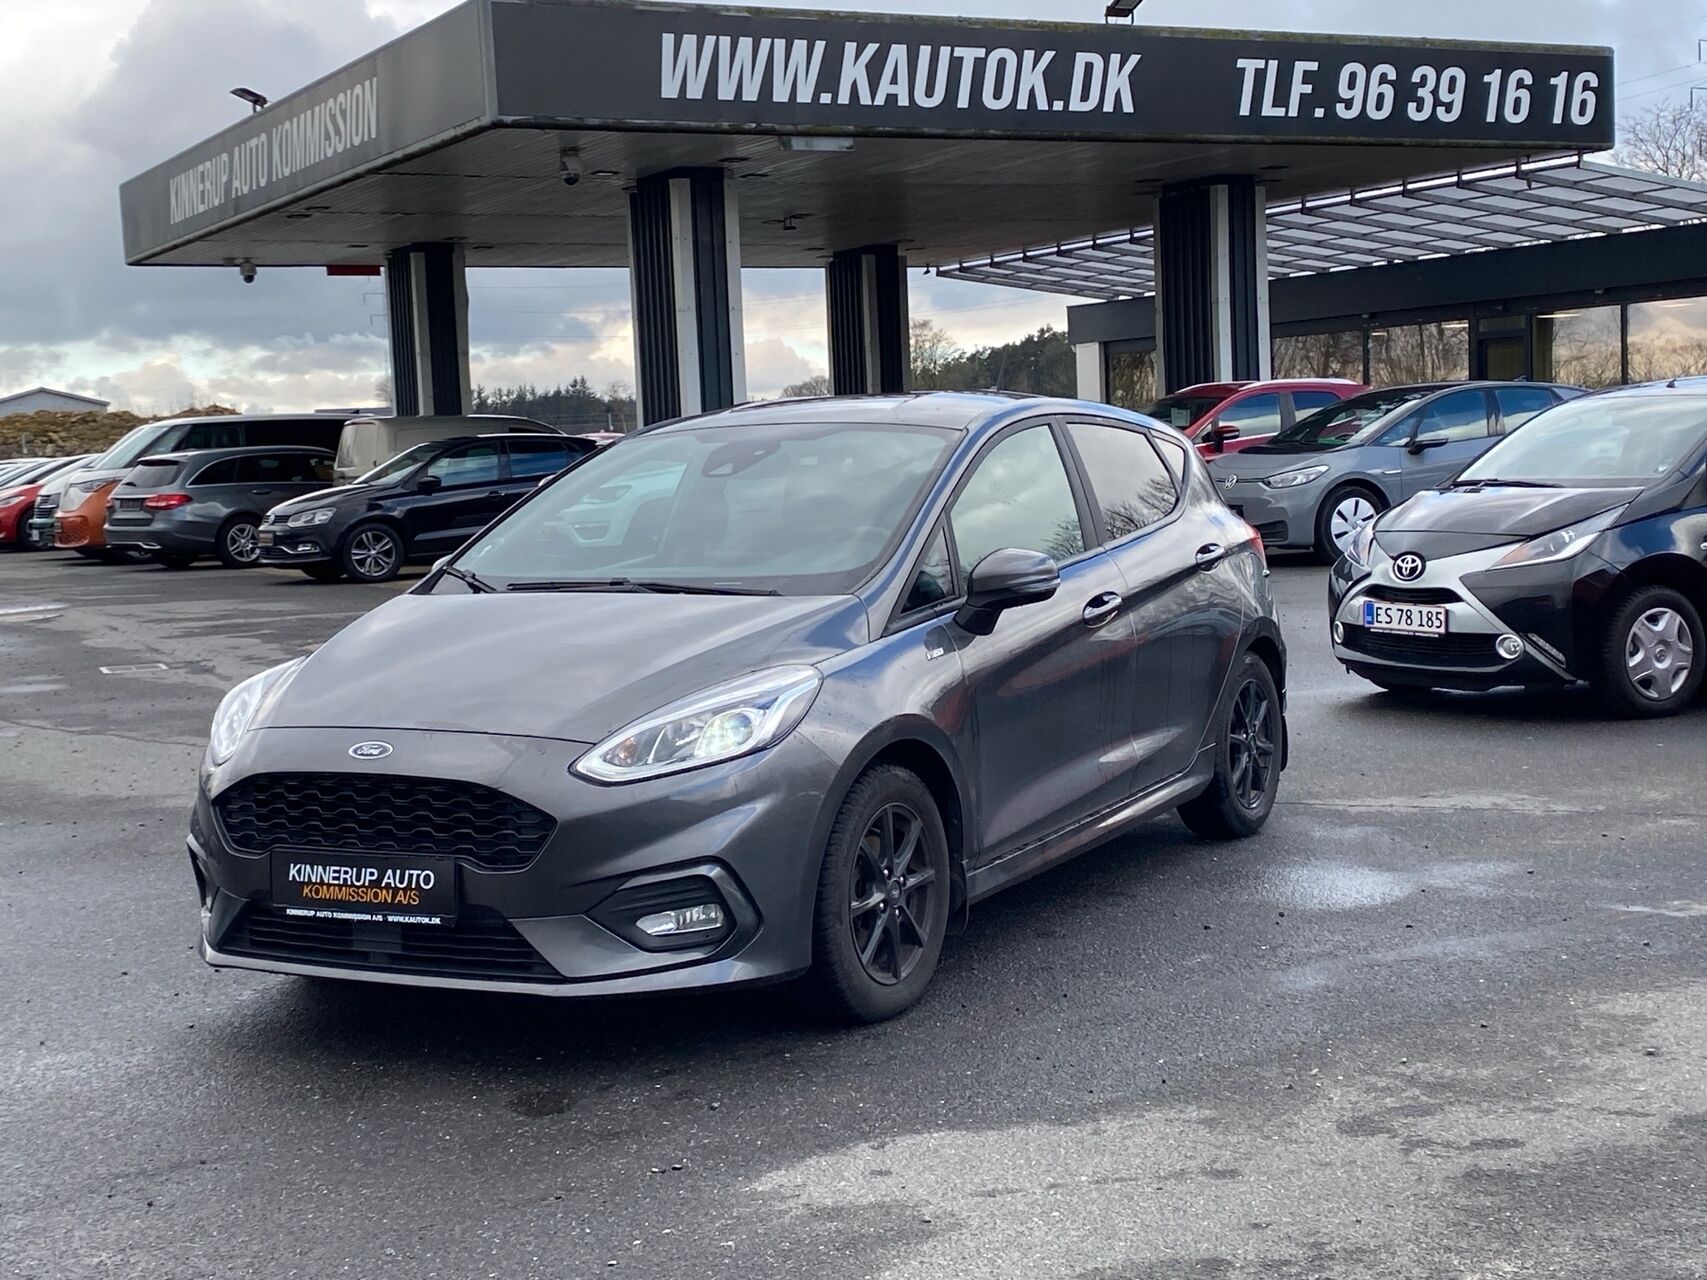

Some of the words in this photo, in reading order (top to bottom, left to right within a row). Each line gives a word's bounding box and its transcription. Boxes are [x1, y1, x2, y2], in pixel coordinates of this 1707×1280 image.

[660, 32, 1142, 114] WWW.KAUTOK.DK
[1236, 58, 1325, 119] TLF.
[1335, 62, 1397, 121] 96
[1407, 65, 1466, 123] 39
[1483, 68, 1534, 125] 16
[1549, 71, 1599, 126] 16
[169, 152, 229, 225] KINNERUP
[231, 132, 268, 199] AUTO
[272, 77, 378, 182] KOMMISSION
[1375, 607, 1393, 625] ES
[1396, 608, 1413, 626] 78
[1417, 610, 1443, 629] 185
[288, 863, 378, 887] KINNERUP
[381, 868, 435, 890] AUTO
[302, 884, 393, 904] KOMMISSION
[395, 890, 420, 905] A/S
